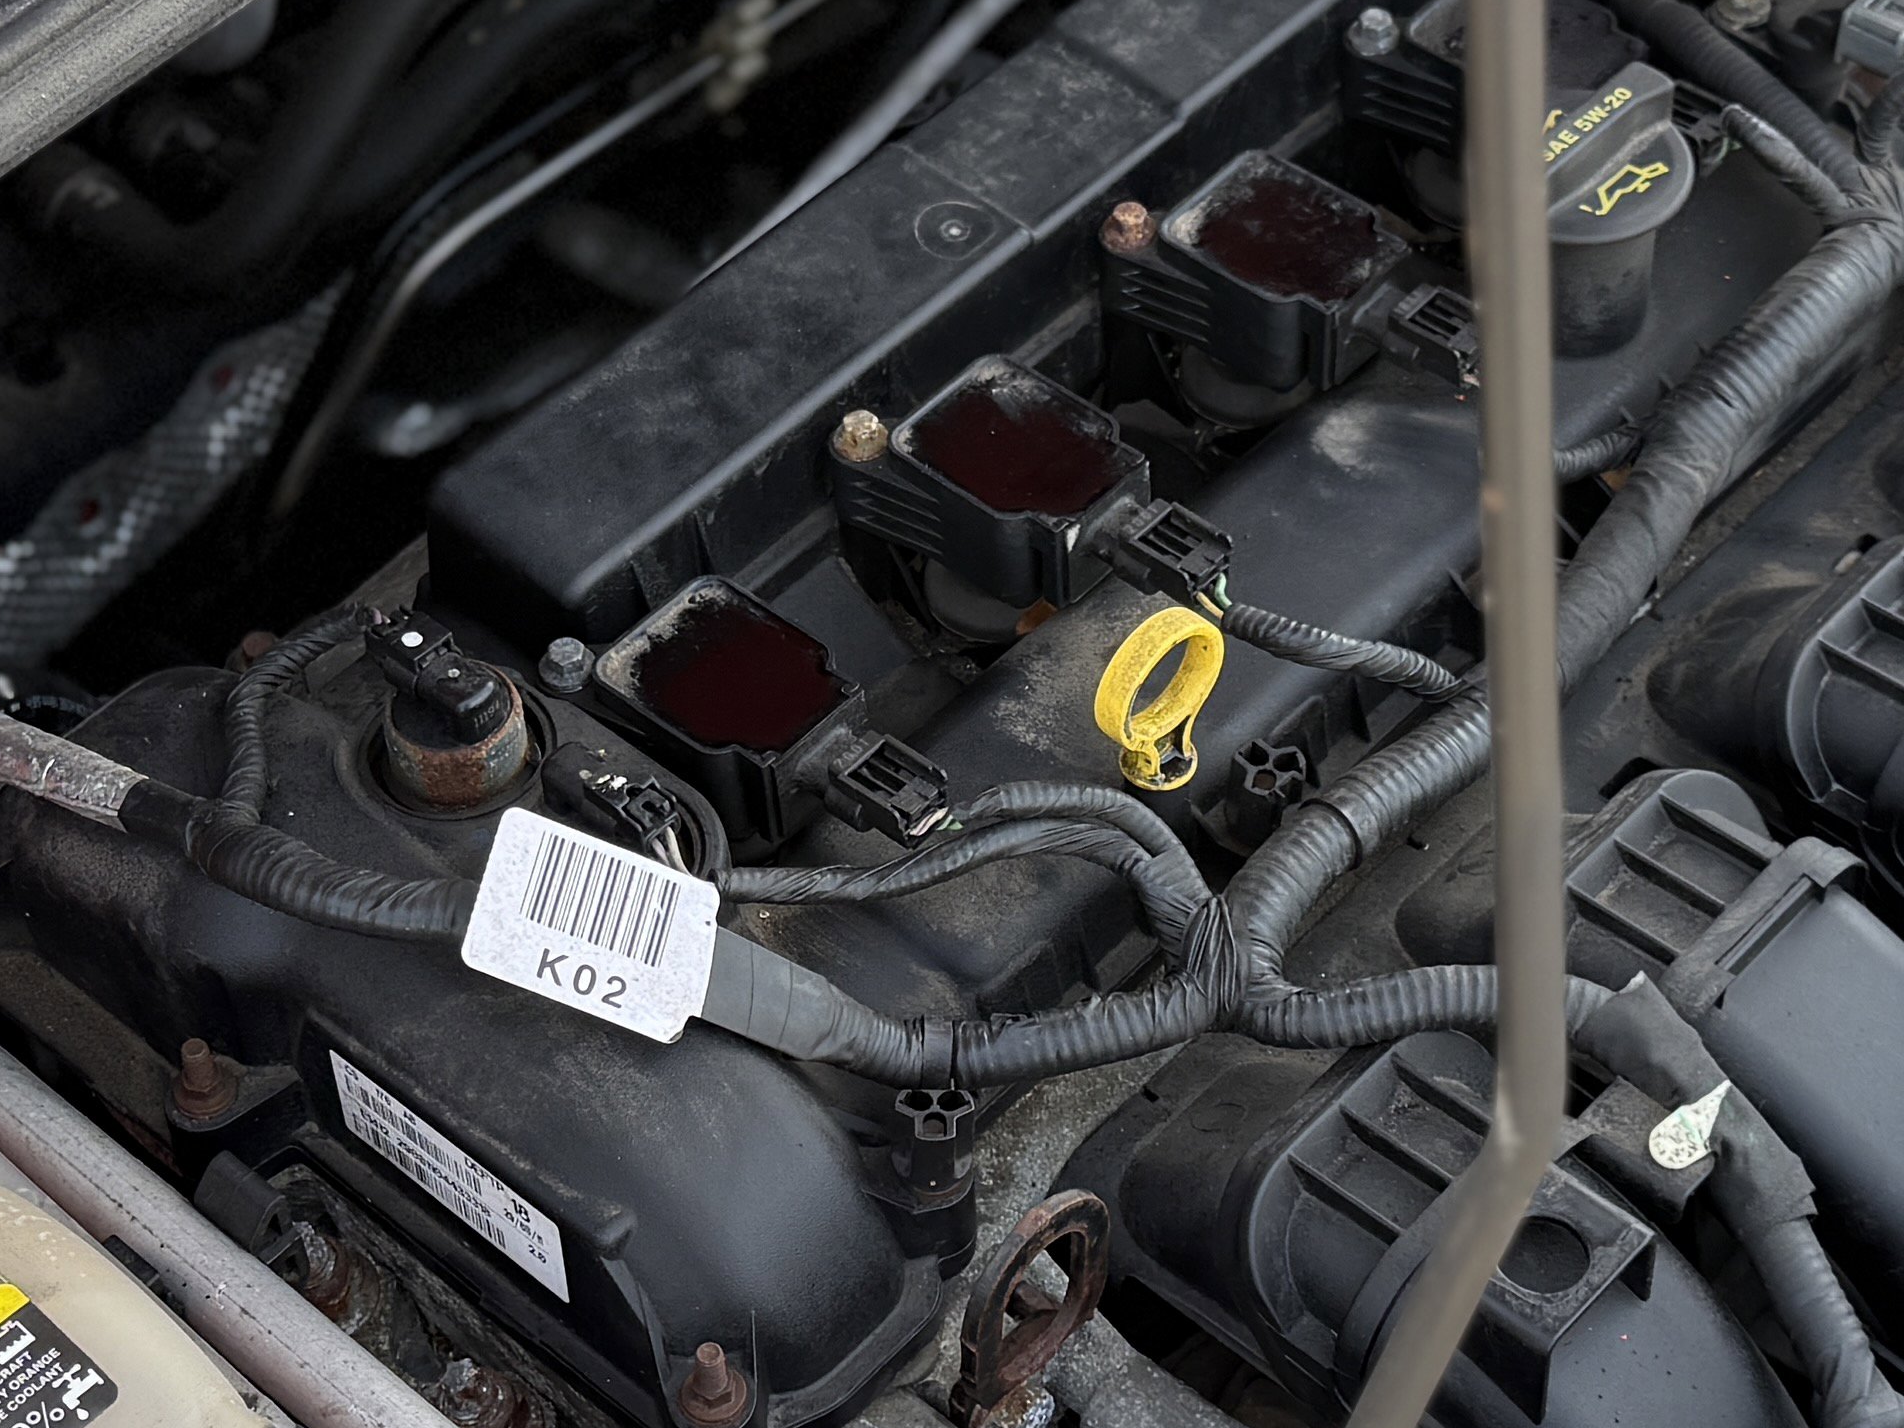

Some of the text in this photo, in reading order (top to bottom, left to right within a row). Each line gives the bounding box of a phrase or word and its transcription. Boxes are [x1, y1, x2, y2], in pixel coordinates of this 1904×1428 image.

[1574, 87, 1633, 133] 5W-20
[537, 948, 628, 1009] K02
[510, 1197, 530, 1222] 18
[7, 1362, 64, 1411] COOLANT
[9, 1347, 61, 1392] ORANGE
